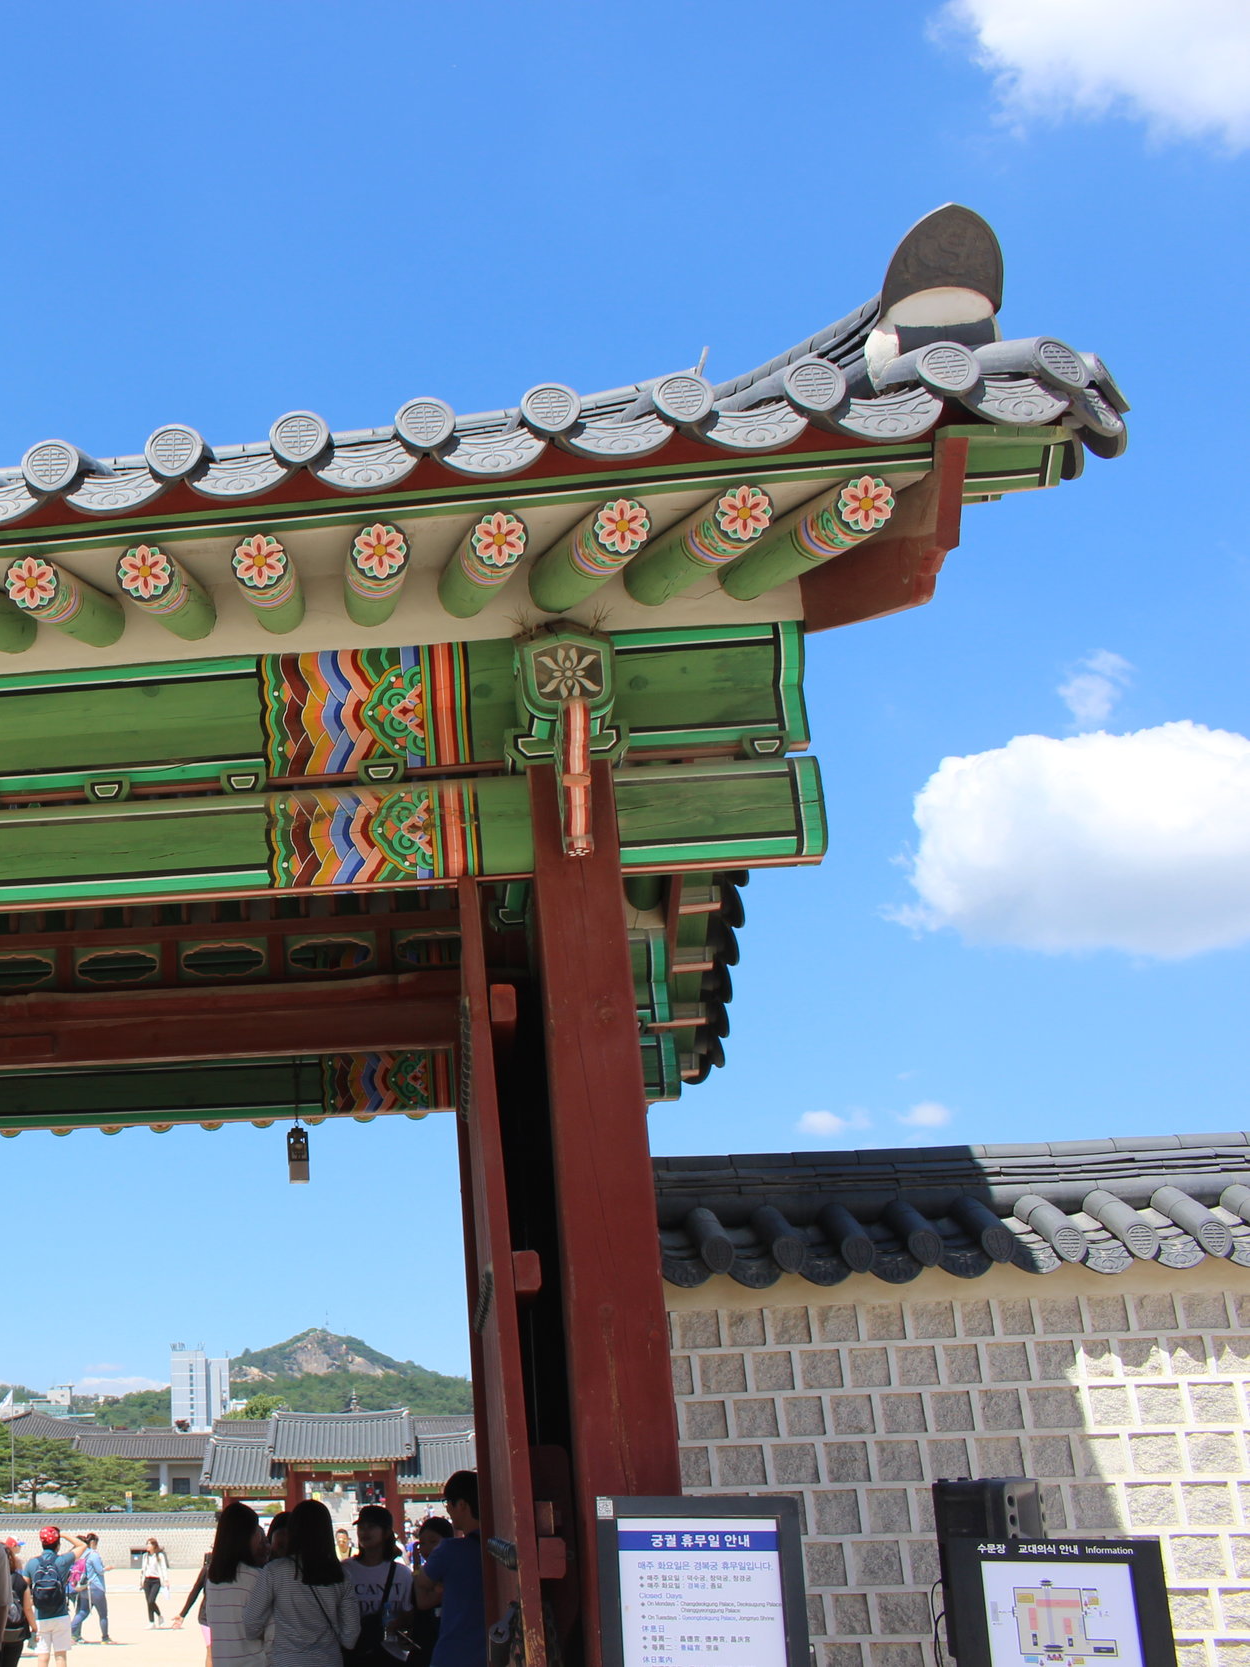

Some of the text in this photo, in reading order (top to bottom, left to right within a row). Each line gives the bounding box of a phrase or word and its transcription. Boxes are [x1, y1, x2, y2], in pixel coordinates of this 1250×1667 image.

[650, 1534, 750, 1548] 궁궐 휴무일 안내
[976, 1543, 1134, 1555] 수문장 교대의식 안내 Information
[638, 1561, 773, 1571] 매주 화요일은 경복궁 휴무일입니다.
[354, 1583, 402, 1595] CANT
